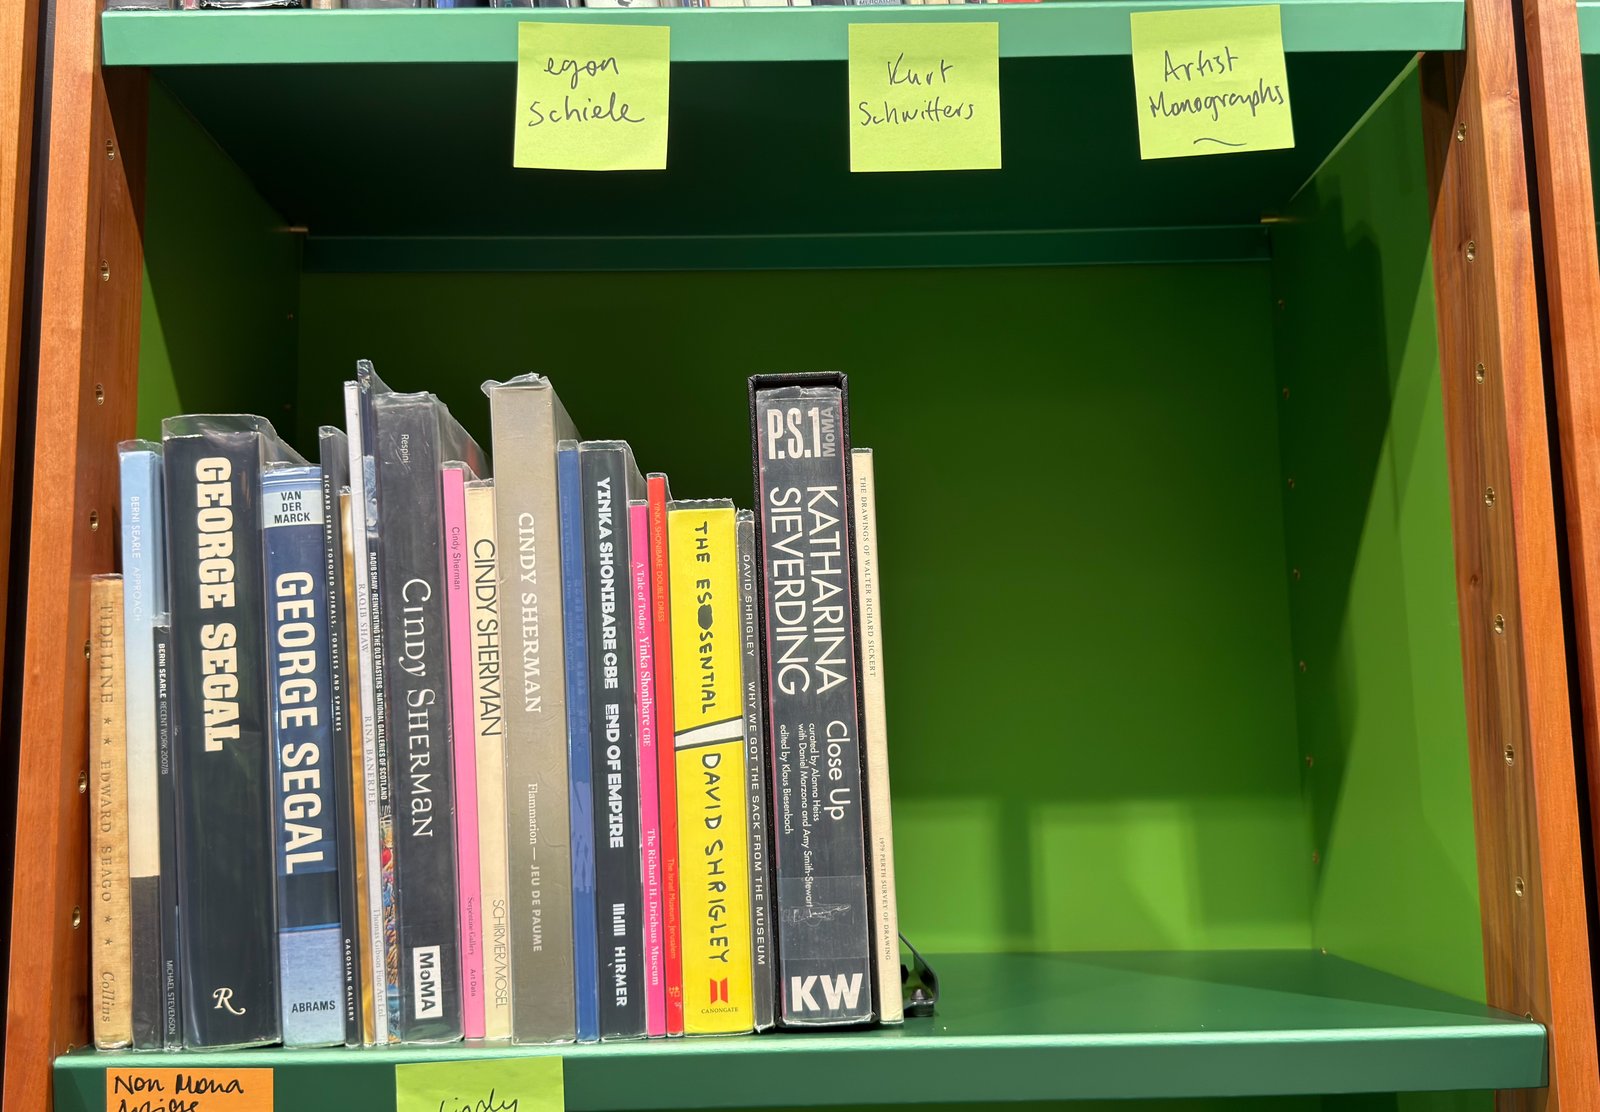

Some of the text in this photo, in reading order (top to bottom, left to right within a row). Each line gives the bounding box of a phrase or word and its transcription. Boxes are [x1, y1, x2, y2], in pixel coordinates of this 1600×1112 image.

[888, 52, 953, 86] Kurt
[1165, 46, 1239, 82] Artist
[859, 96, 974, 126] Schwitters
[1149, 78, 1284, 122] Monographs
[400, 434, 411, 463] Respini
[822, 407, 836, 457] MoMA
[280, 491, 302, 501] VAN
[281, 504, 301, 512] DER
[653, 501, 661, 525] YINKA
[274, 515, 311, 524] MARCK
[325, 515, 333, 544] SERRA:
[131, 496, 142, 621] BERNI SEARLE APPROACH
[451, 527, 462, 590] Cindy Sherman
[694, 521, 711, 562] THE
[327, 548, 335, 586] TORQUED
[597, 476, 619, 689] YINKA SHONIBARE CBE
[656, 570, 664, 598] DOUBLE
[859, 477, 875, 677] THE DRAWINGS OF WALTER RICHARD SICKERT
[196, 457, 240, 752] GEORGE SEGAL
[769, 486, 809, 695] SIEVERDING
[807, 485, 847, 694] KATHARINA
[518, 512, 541, 712] CINDY SHERMAN
[657, 601, 665, 622] DRESS
[158, 643, 166, 666] BERNI
[331, 633, 339, 669] TORUSES
[474, 539, 501, 736] CINDY SHERMAN
[636, 561, 653, 746] A Tale of Today: Yinka Shonibare CBE
[159, 669, 167, 698] SEARLE
[375, 660, 383, 688] MASTERS
[357, 583, 376, 806] RAQIB SHAW RINA BANERJEE
[376, 692, 384, 723] NATIONAL
[276, 571, 324, 874] GEORGE SEGAL
[377, 724, 385, 757] GALLERIES
[161, 750, 169, 775] 2007/8
[379, 758, 386, 766] OF
[606, 703, 624, 848] END OF EMPIRE
[742, 554, 765, 965] DAVID SHRIGLEY WHY WE GOT THE SACK FROM THE MUSEUM
[808, 723, 822, 821] curated by Alanna Heiss
[823, 720, 850, 821] Close Up
[380, 767, 388, 800] SCOTLAND
[779, 724, 793, 834] edited by Klaus Biesenbach
[100, 603, 115, 1022] TIDELINE EDWARD SEAGO Collins
[797, 723, 815, 907] with Daniel Marzona and Amy Smith-Stewart
[528, 783, 543, 952] Flammarion JEU DE PAUME
[667, 859, 675, 871] The
[701, 753, 729, 962] DAVID SHRIGLEY
[879, 854, 887, 878] PERTH
[668, 873, 676, 891] Israel
[373, 909, 381, 938] Thomas
[466, 897, 475, 929] Serpentine
[647, 828, 660, 986] The Richard H. Driehaus Museum
[883, 912, 889, 922] OF
[345, 938, 353, 981] GAGOSIAN
[374, 940, 382, 967] Gibson
[467, 931, 476, 955] Gallery
[492, 899, 507, 1008] SCHIRMER/MOSEL
[669, 925, 677, 959] Jerusalem
[882, 924, 891, 961] DRAWING
[376, 970, 384, 986] Fine
[419, 952, 436, 1011] MoMA
[615, 946, 628, 1006] HIRMER
[791, 972, 863, 1012] KW
[166, 960, 176, 1034] MICHAEL STEVENSON
[292, 1001, 336, 1012] ABRAMS
[114, 1075, 164, 1094] Non
